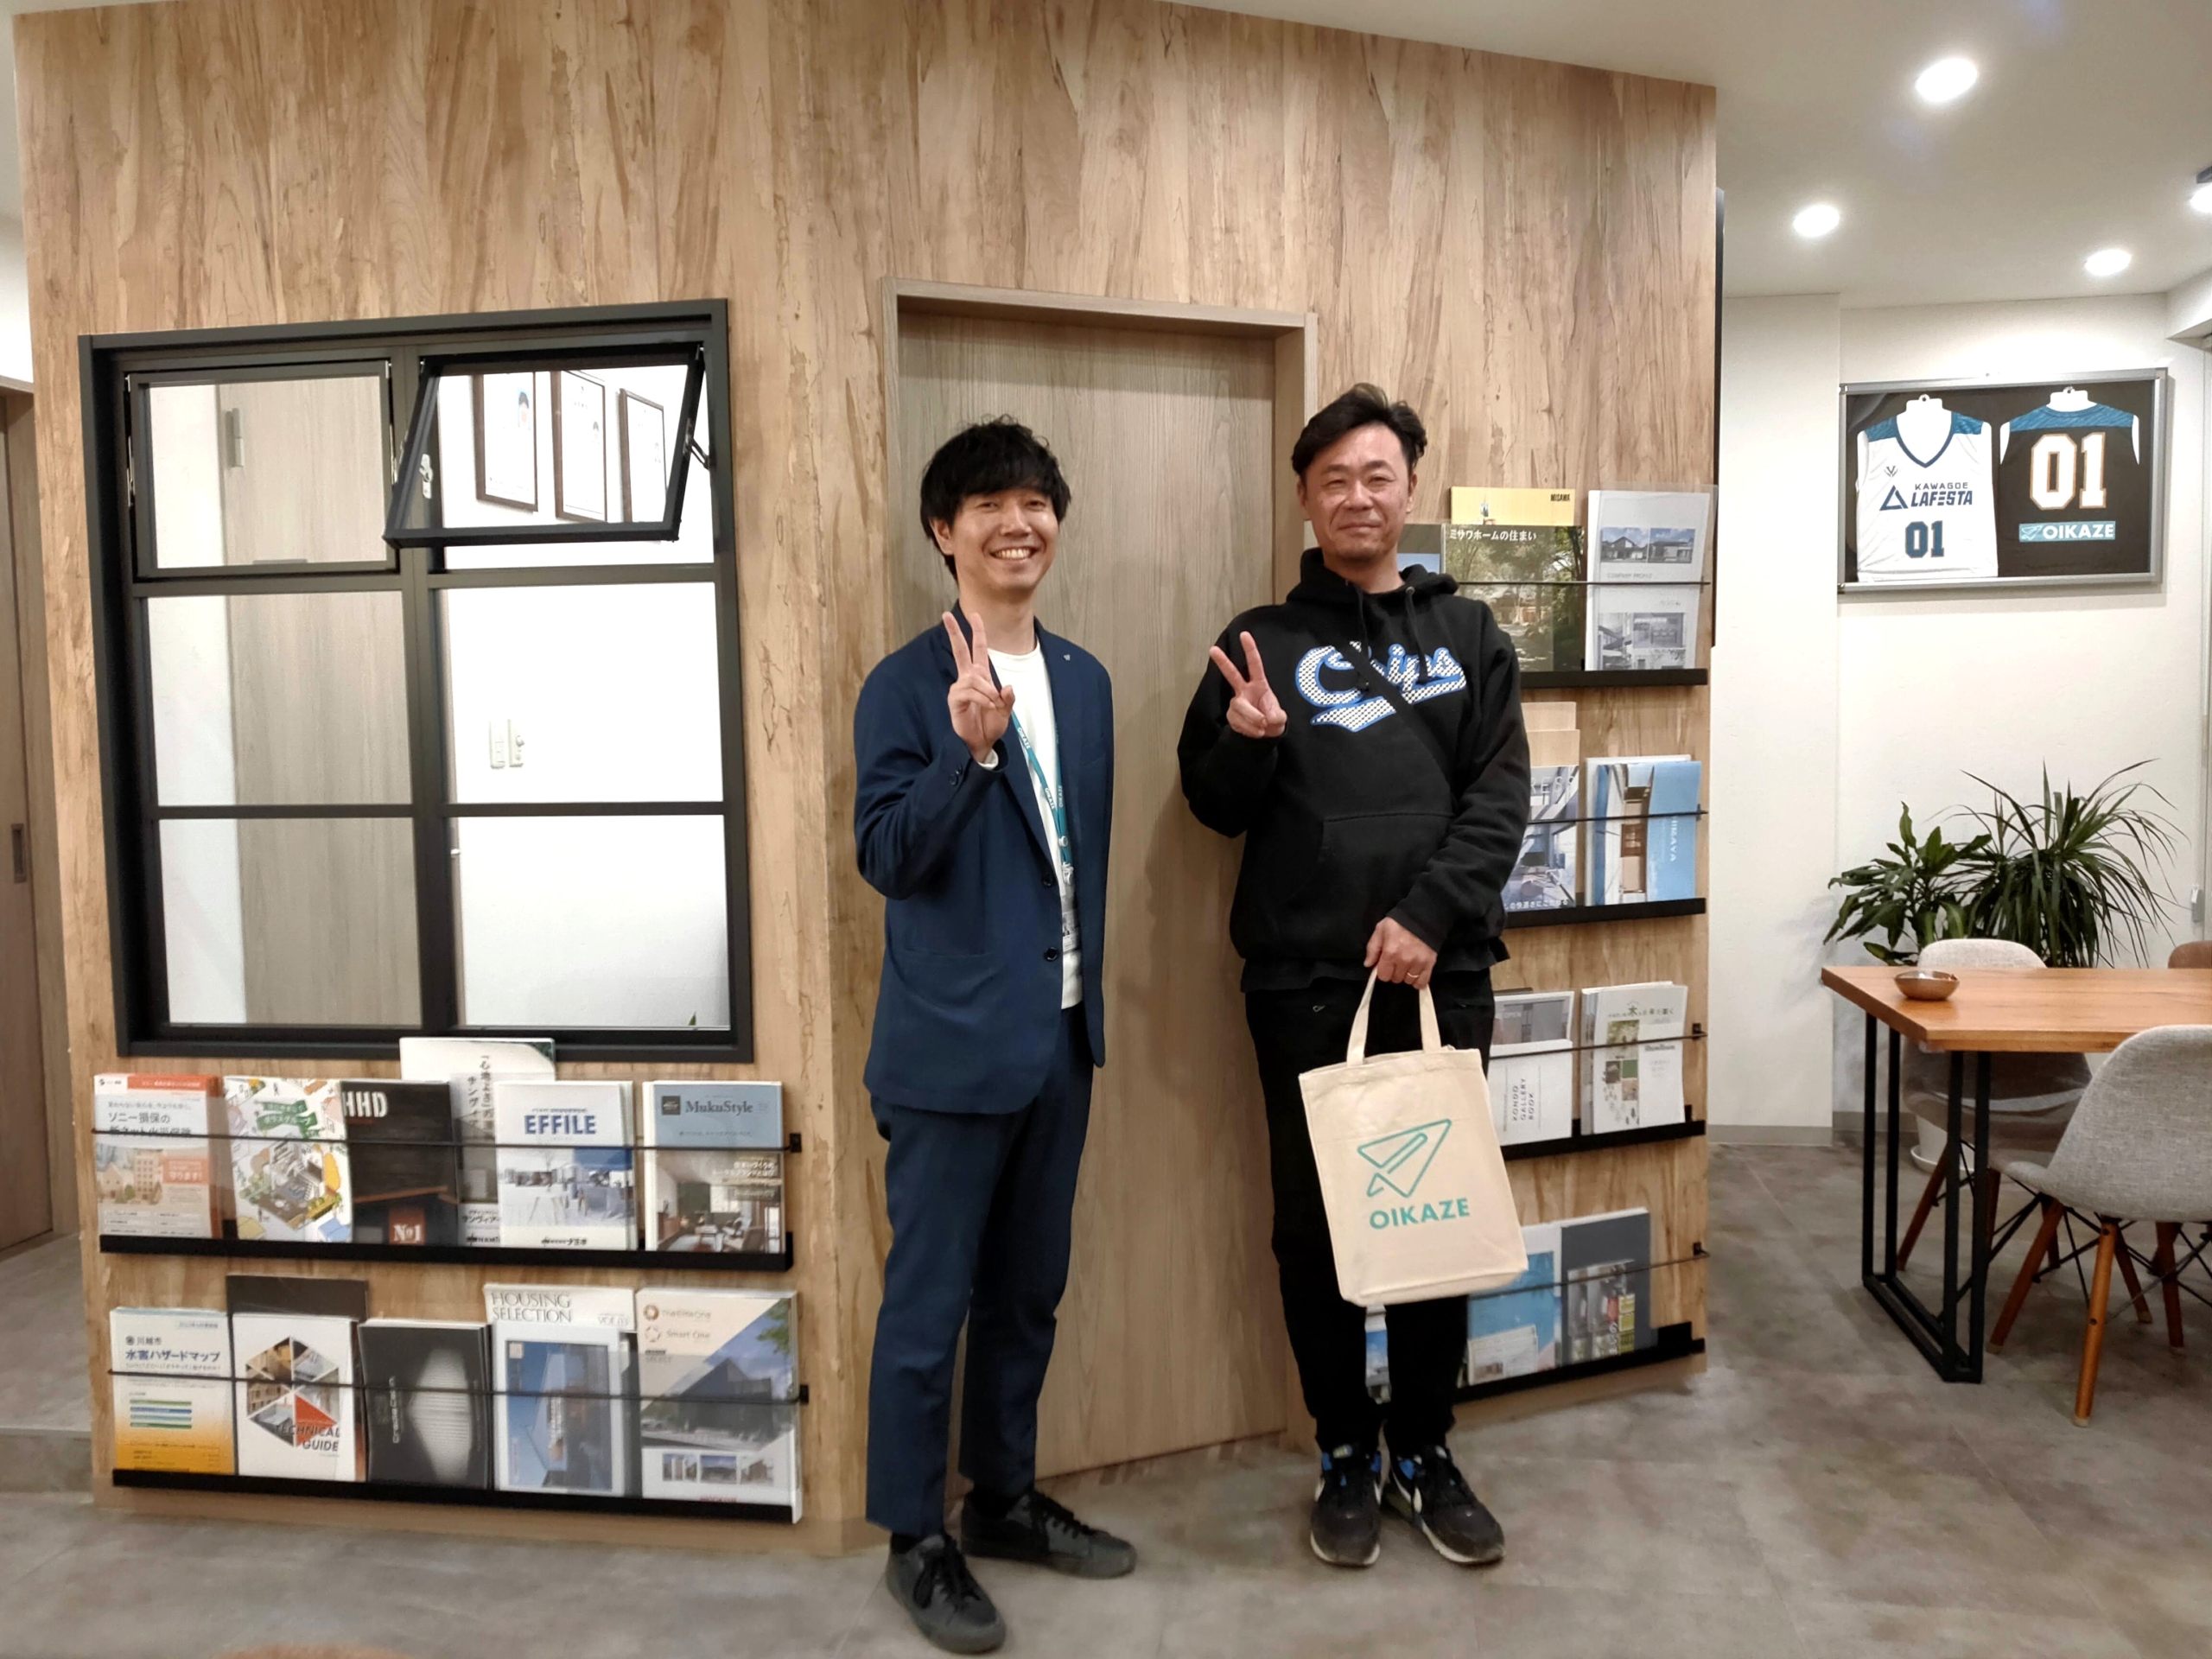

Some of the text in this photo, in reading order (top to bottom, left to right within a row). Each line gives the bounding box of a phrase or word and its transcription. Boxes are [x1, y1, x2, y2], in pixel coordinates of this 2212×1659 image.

[2030, 432, 2107, 510] 01
[1910, 490, 1973, 507] LAFESTA
[1449, 529, 1537, 541] ミサワホームの住まい
[1904, 520, 1945, 558] 01
[2042, 524, 2114, 539] OIKAZE
[685, 1100, 753, 1116] MukuStyle
[109, 1112, 171, 1124] ソニー損保の
[524, 1115, 596, 1135] EFFILE
[1369, 1198, 1471, 1230] OIKAZE
[491, 1291, 571, 1308] HOUSING
[493, 1306, 572, 1323] SELECTION
[125, 1350, 221, 1363] 水害ハザードマップ
[275, 1423, 340, 1439] TECHNICAL
[302, 1440, 340, 1452] GUIDE
